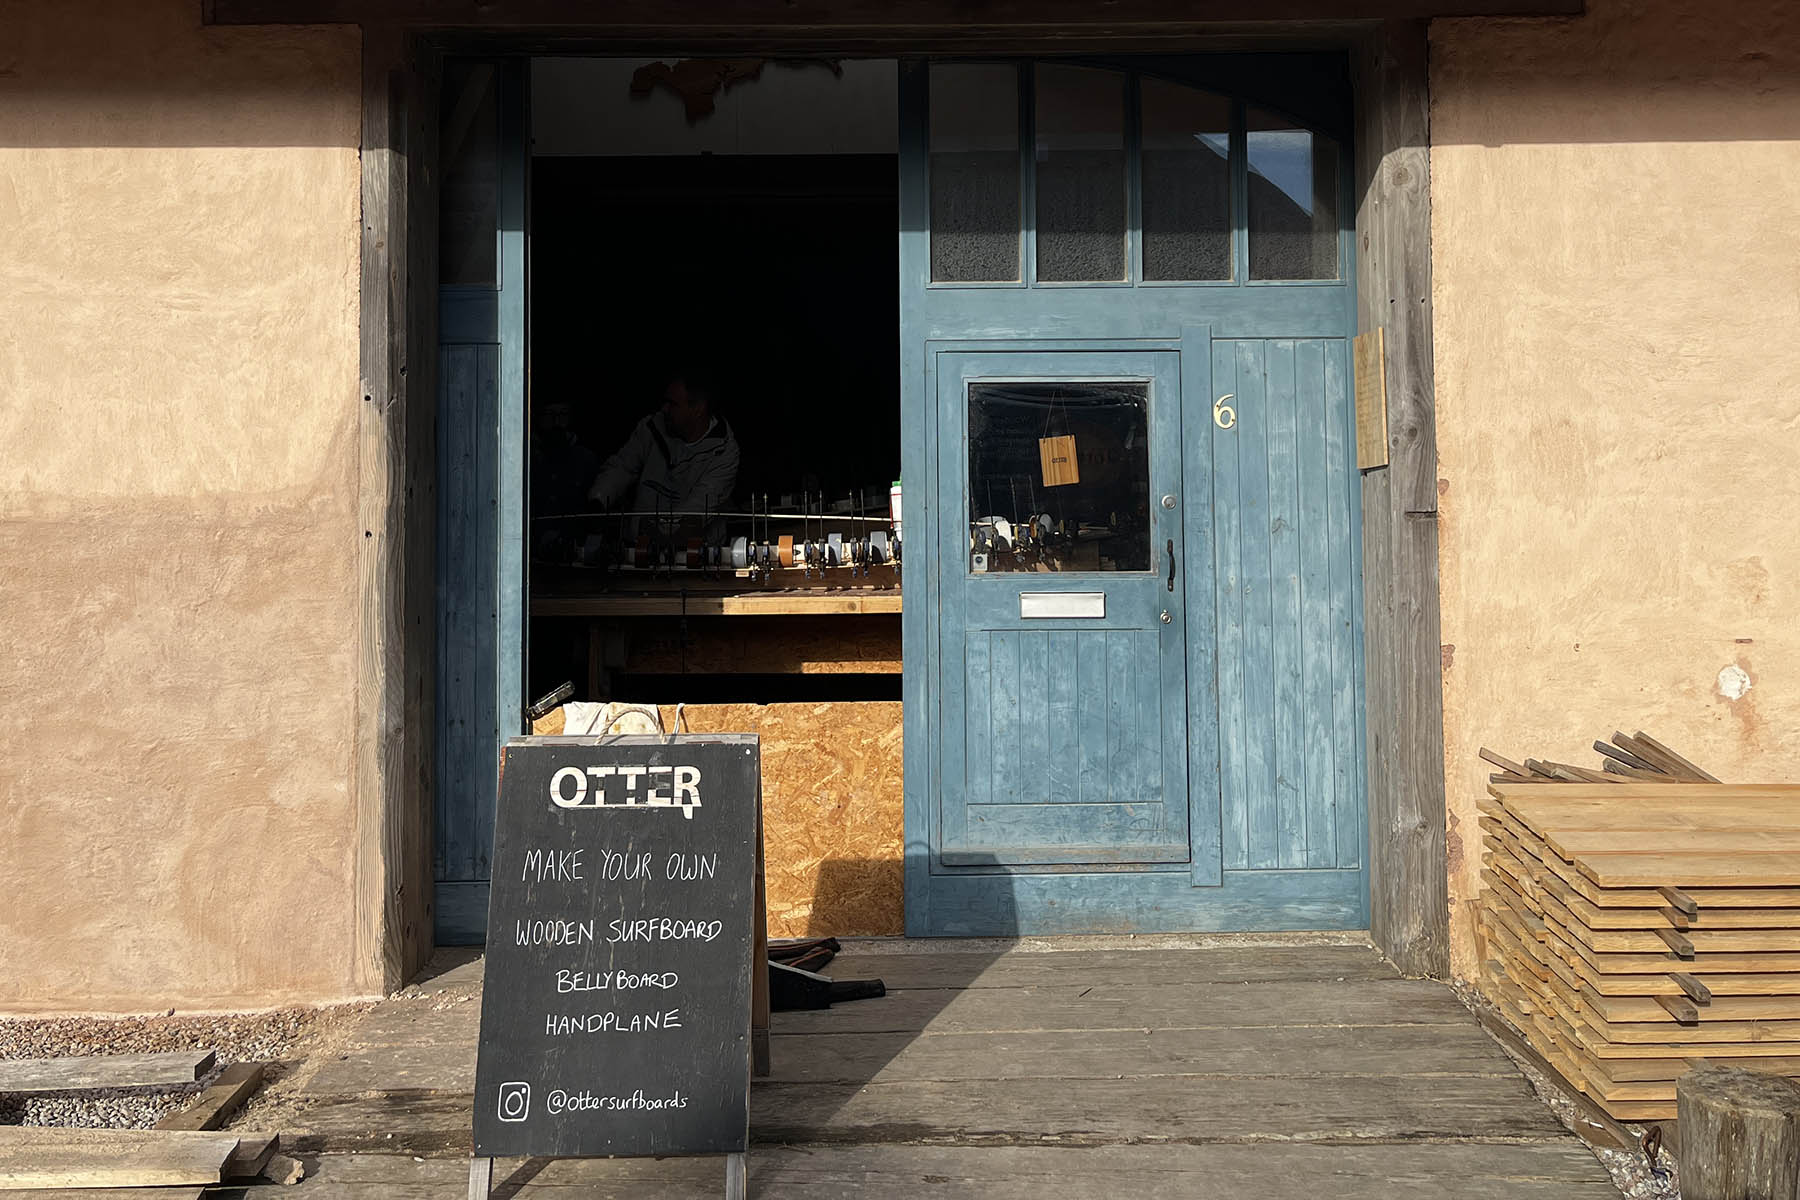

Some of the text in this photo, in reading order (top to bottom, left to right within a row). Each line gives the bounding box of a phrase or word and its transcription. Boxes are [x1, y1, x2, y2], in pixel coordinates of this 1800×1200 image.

[1213, 394, 1236, 429] 6
[549, 765, 703, 820] OTTER
[522, 848, 717, 884] MAKE YOUR OWN
[515, 917, 723, 946] WOODEN SURFBOARD
[545, 1008, 683, 1036] HANDPLANE
[546, 1089, 688, 1115] @ottersurfboards
